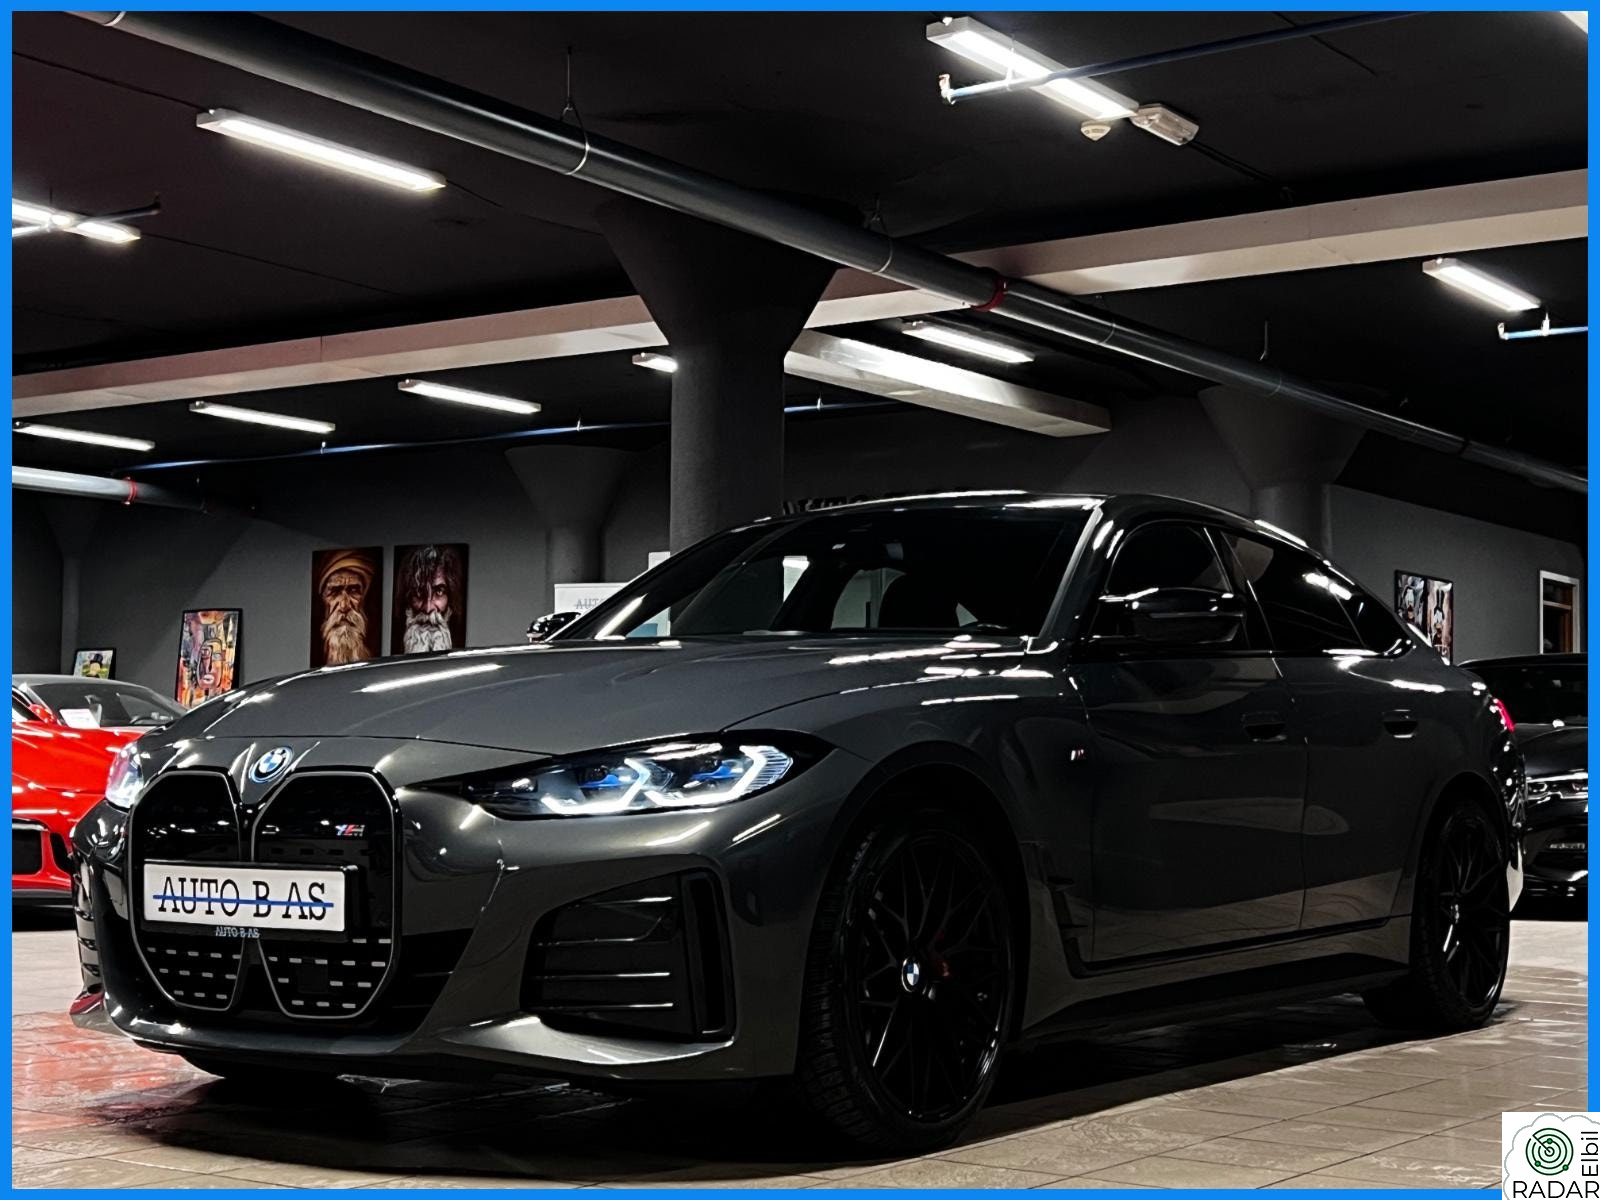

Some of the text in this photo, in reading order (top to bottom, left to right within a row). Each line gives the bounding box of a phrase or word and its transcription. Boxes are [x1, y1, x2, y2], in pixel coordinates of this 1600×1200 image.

[575, 598, 606, 610] AUT
[158, 876, 327, 921] AUTO B AS
[215, 926, 238, 938] AUTO
[247, 928, 260, 939] AS
